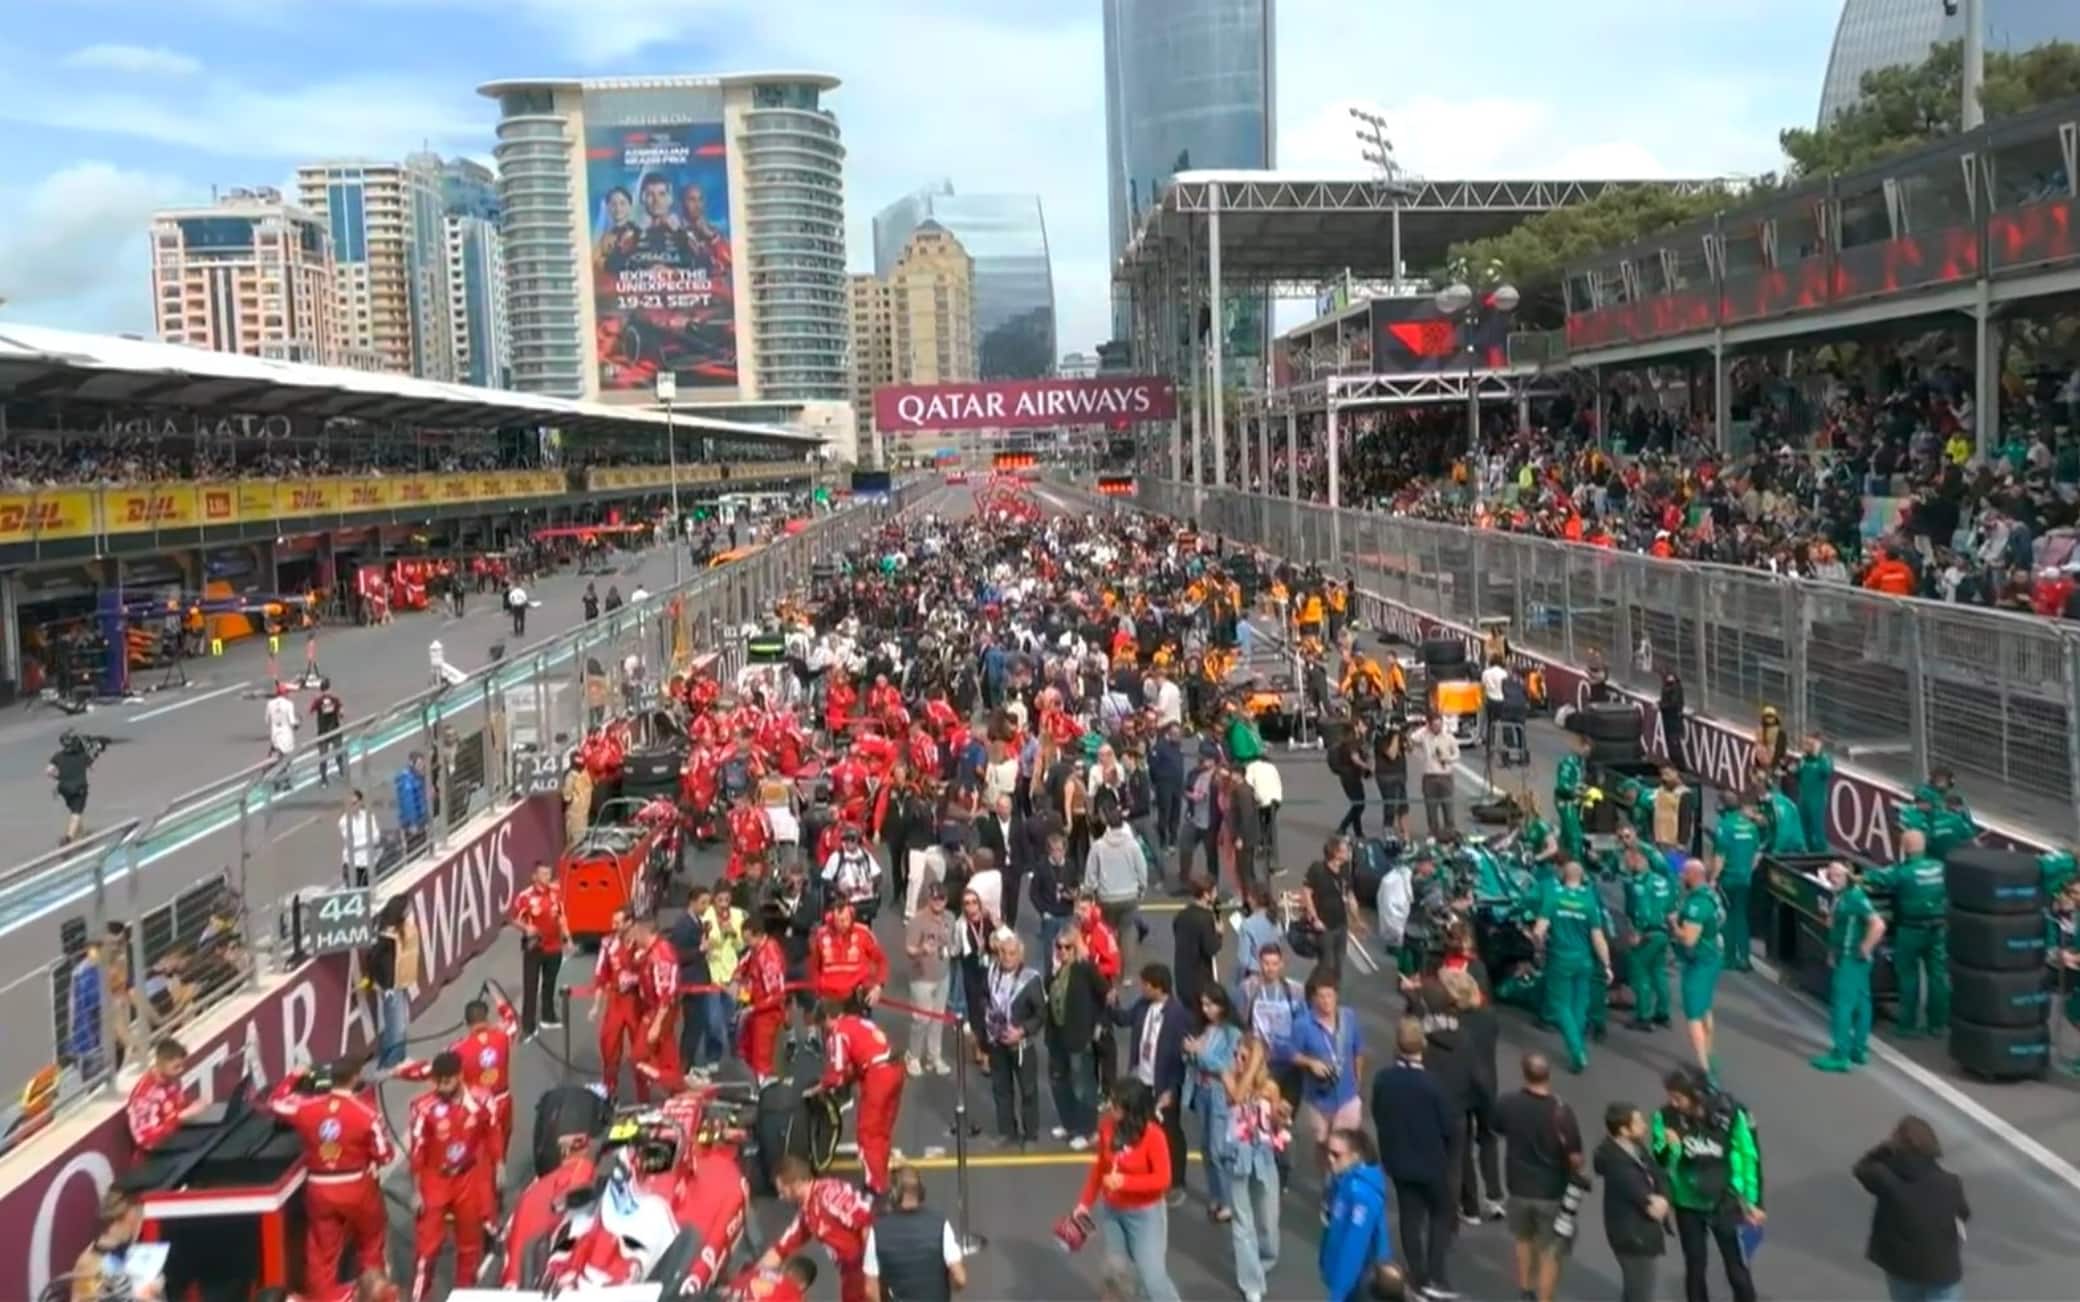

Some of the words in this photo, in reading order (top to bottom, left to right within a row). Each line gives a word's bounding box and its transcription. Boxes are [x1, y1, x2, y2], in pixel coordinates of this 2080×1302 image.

[619, 270, 676, 283] EXPECT
[679, 268, 708, 282] THE
[616, 281, 712, 293] UNEXPECTED
[617, 295, 663, 309] 19-21
[667, 293, 713, 308] SEPT
[898, 393, 1005, 426] QATAR
[1015, 386, 1151, 417] AIRWAYS
[127, 496, 177, 522] DHL
[291, 489, 325, 509] DHL
[0, 503, 63, 531] DHL
[531, 756, 557, 775] 14
[530, 778, 559, 793] ALO
[319, 894, 366, 922] 44
[317, 926, 369, 949] HAM
